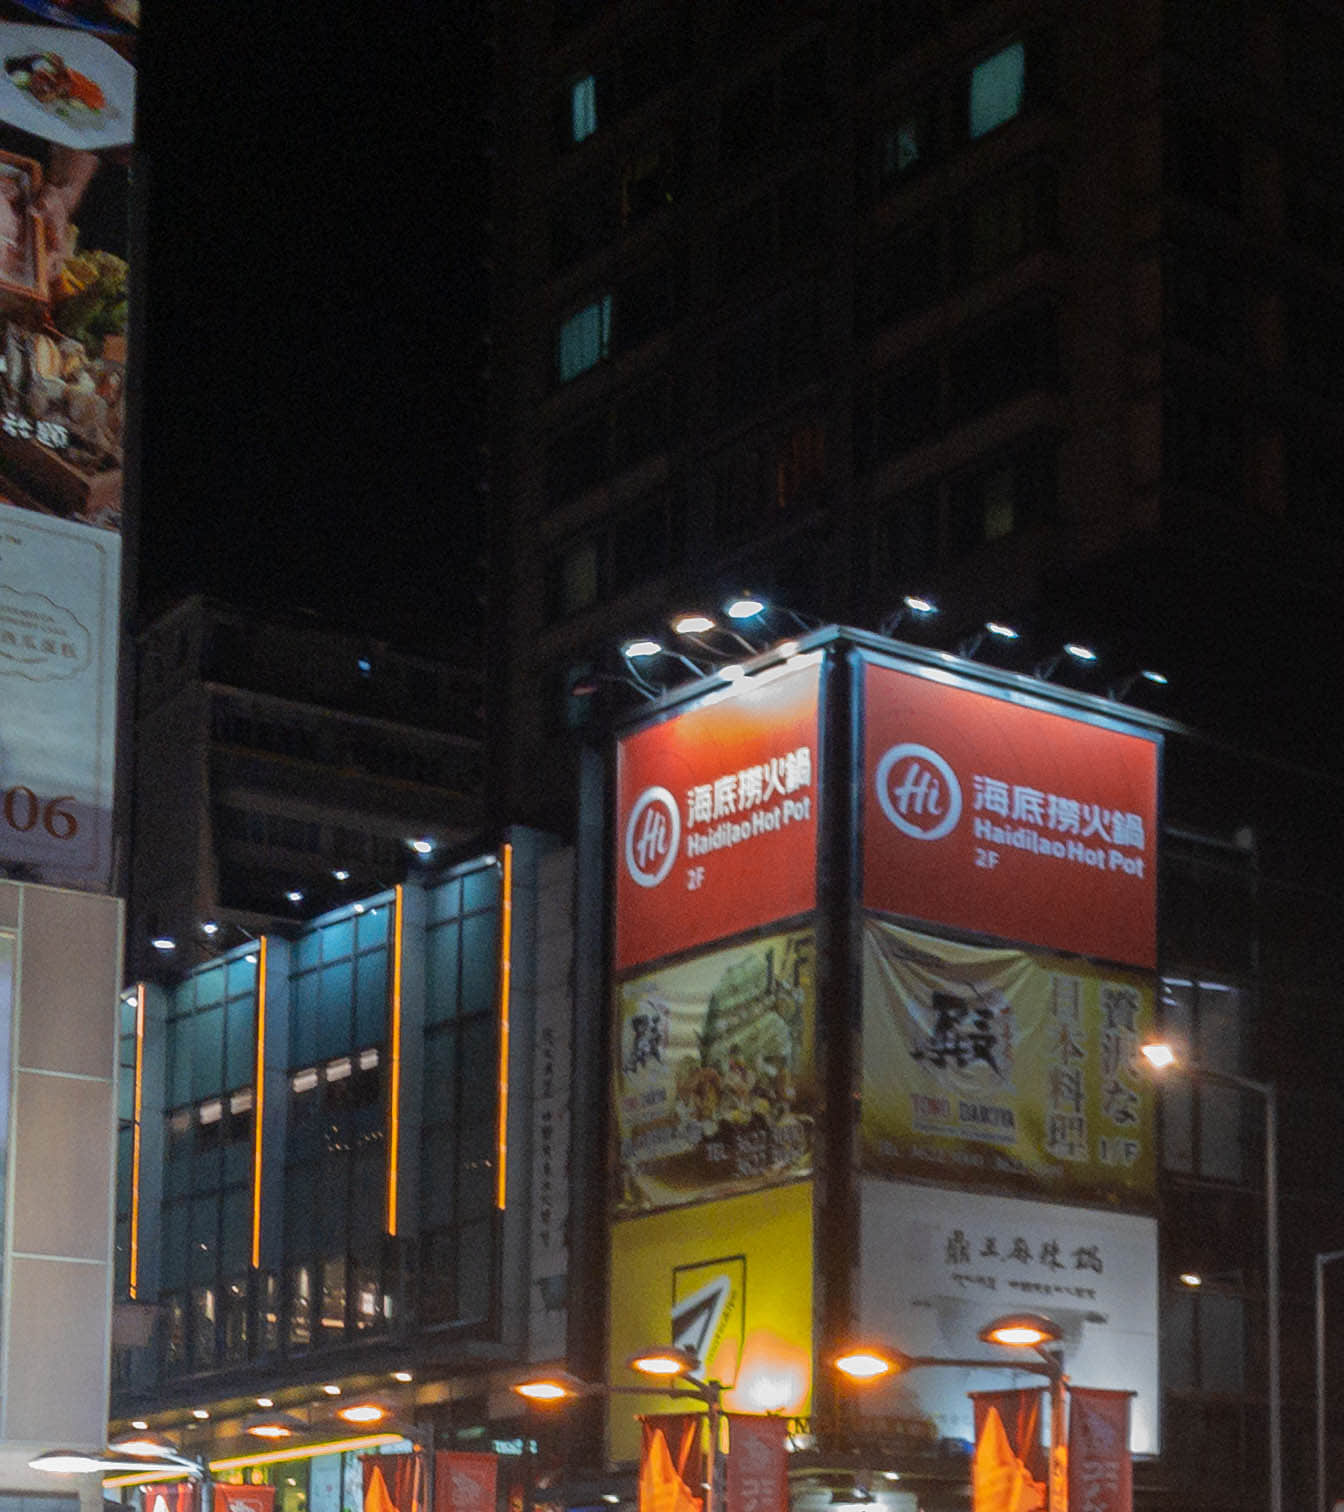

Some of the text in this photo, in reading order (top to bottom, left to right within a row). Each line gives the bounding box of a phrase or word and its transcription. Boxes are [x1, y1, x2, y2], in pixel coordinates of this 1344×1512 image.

[687, 747, 812, 828] 海底撈火鍋
[973, 774, 1145, 850] 海底撈火鍋
[687, 797, 812, 858] Haidilao Hot Pot
[973, 818, 1145, 879] Haidilao Hot Pot
